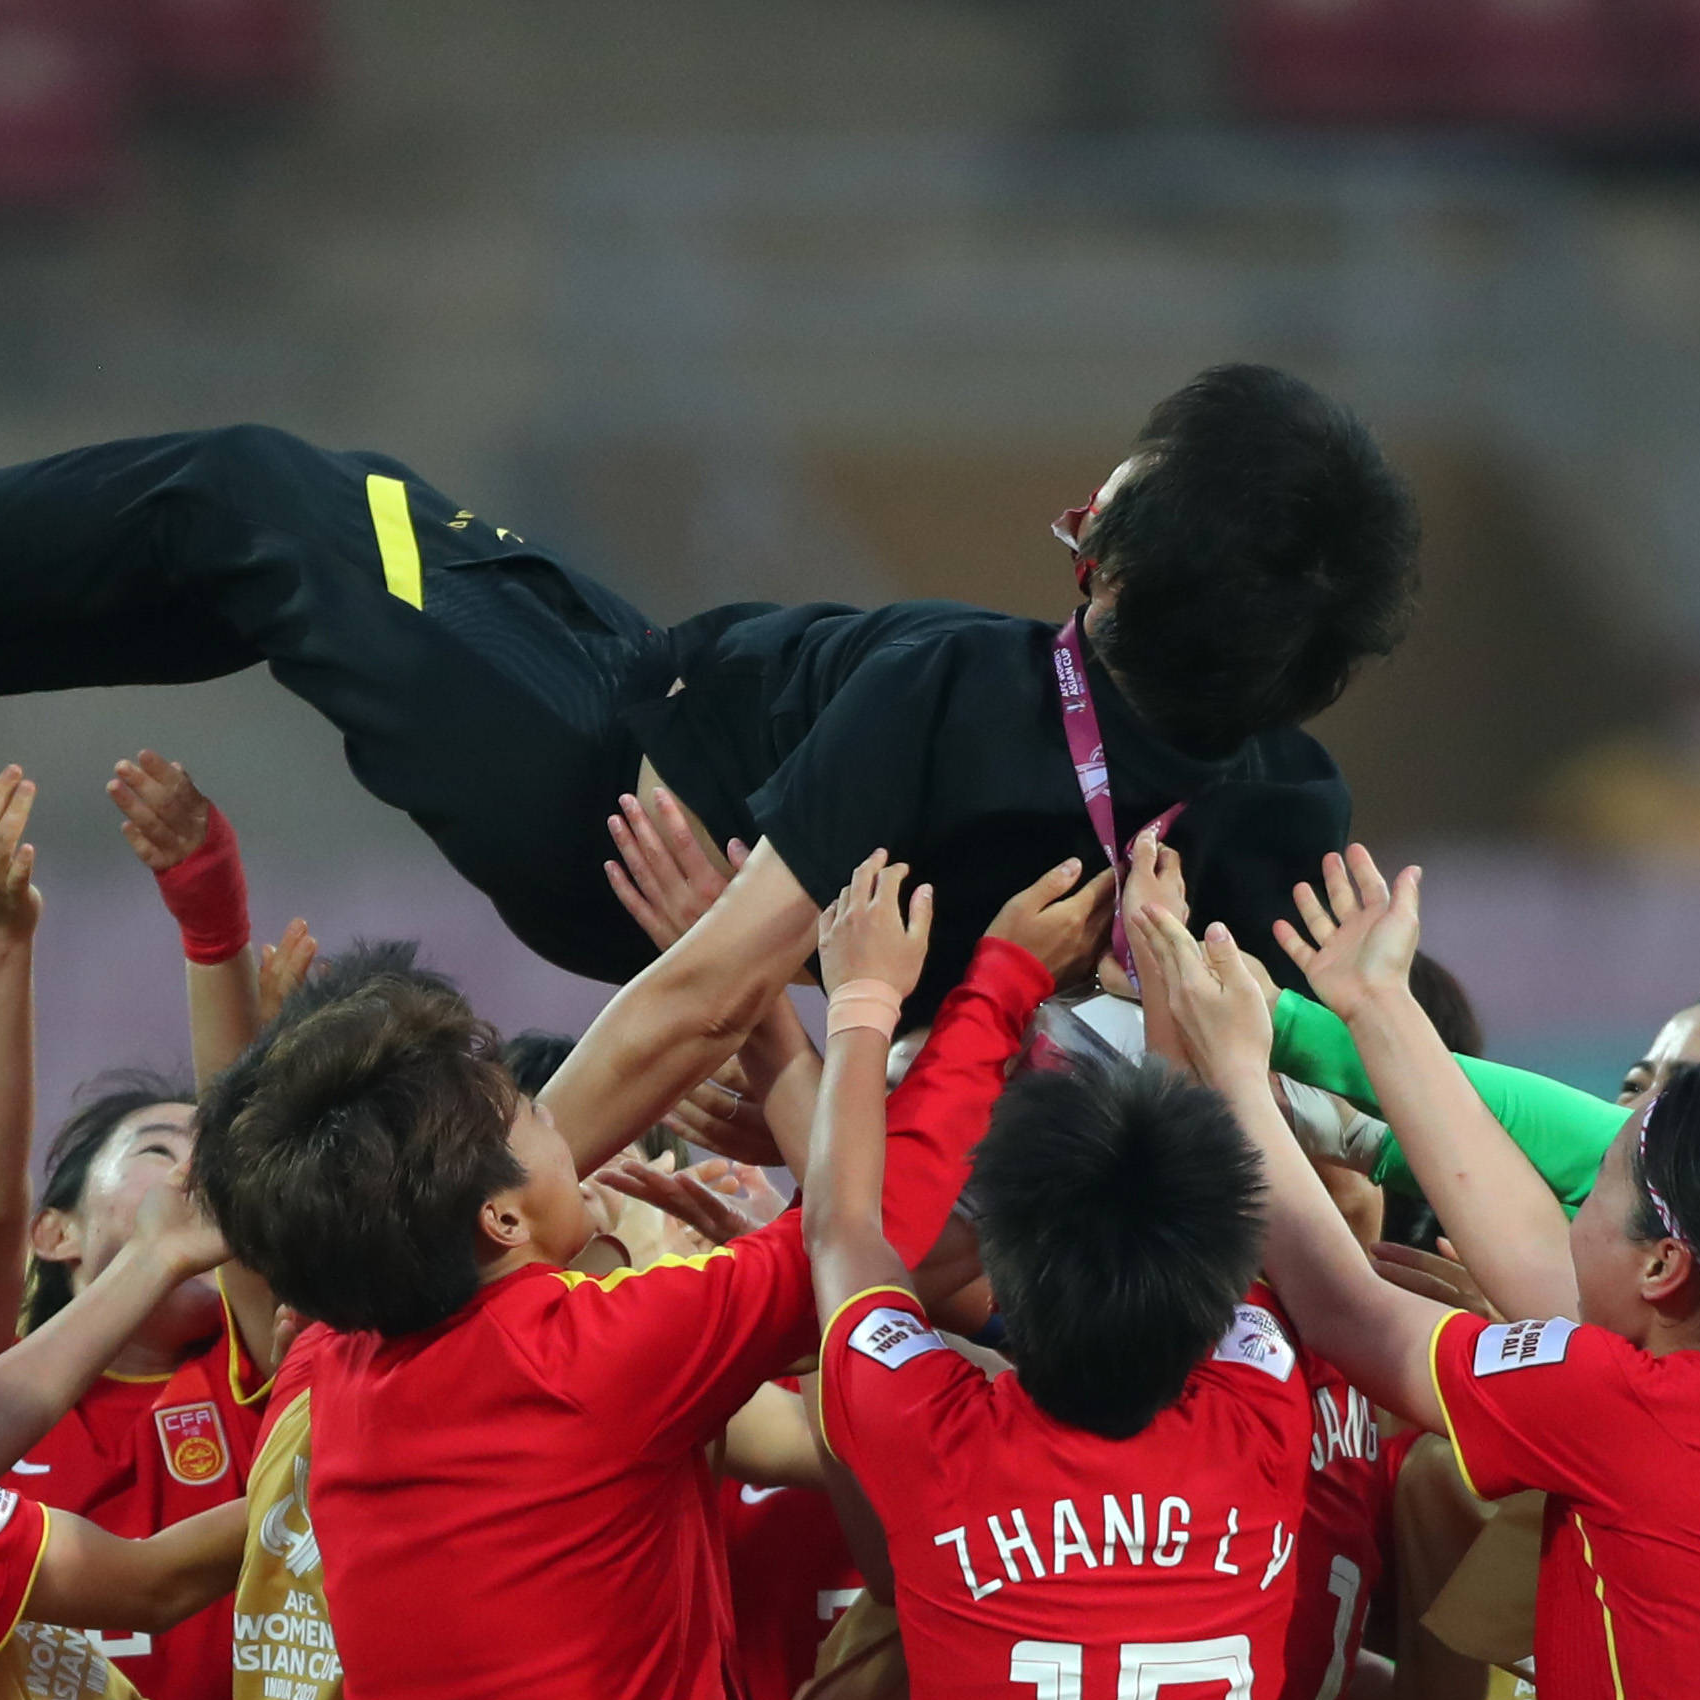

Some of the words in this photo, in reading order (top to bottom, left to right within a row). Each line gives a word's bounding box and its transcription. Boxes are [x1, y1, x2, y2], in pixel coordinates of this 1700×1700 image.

[1500, 1337, 1520, 1361] ALL
[1519, 1331, 1541, 1363] GOAL
[164, 1409, 211, 1432] CFA
[934, 1493, 1191, 1601] ZHANG
[283, 1589, 318, 1616] AFC
[264, 1676, 293, 1700] INDIA
